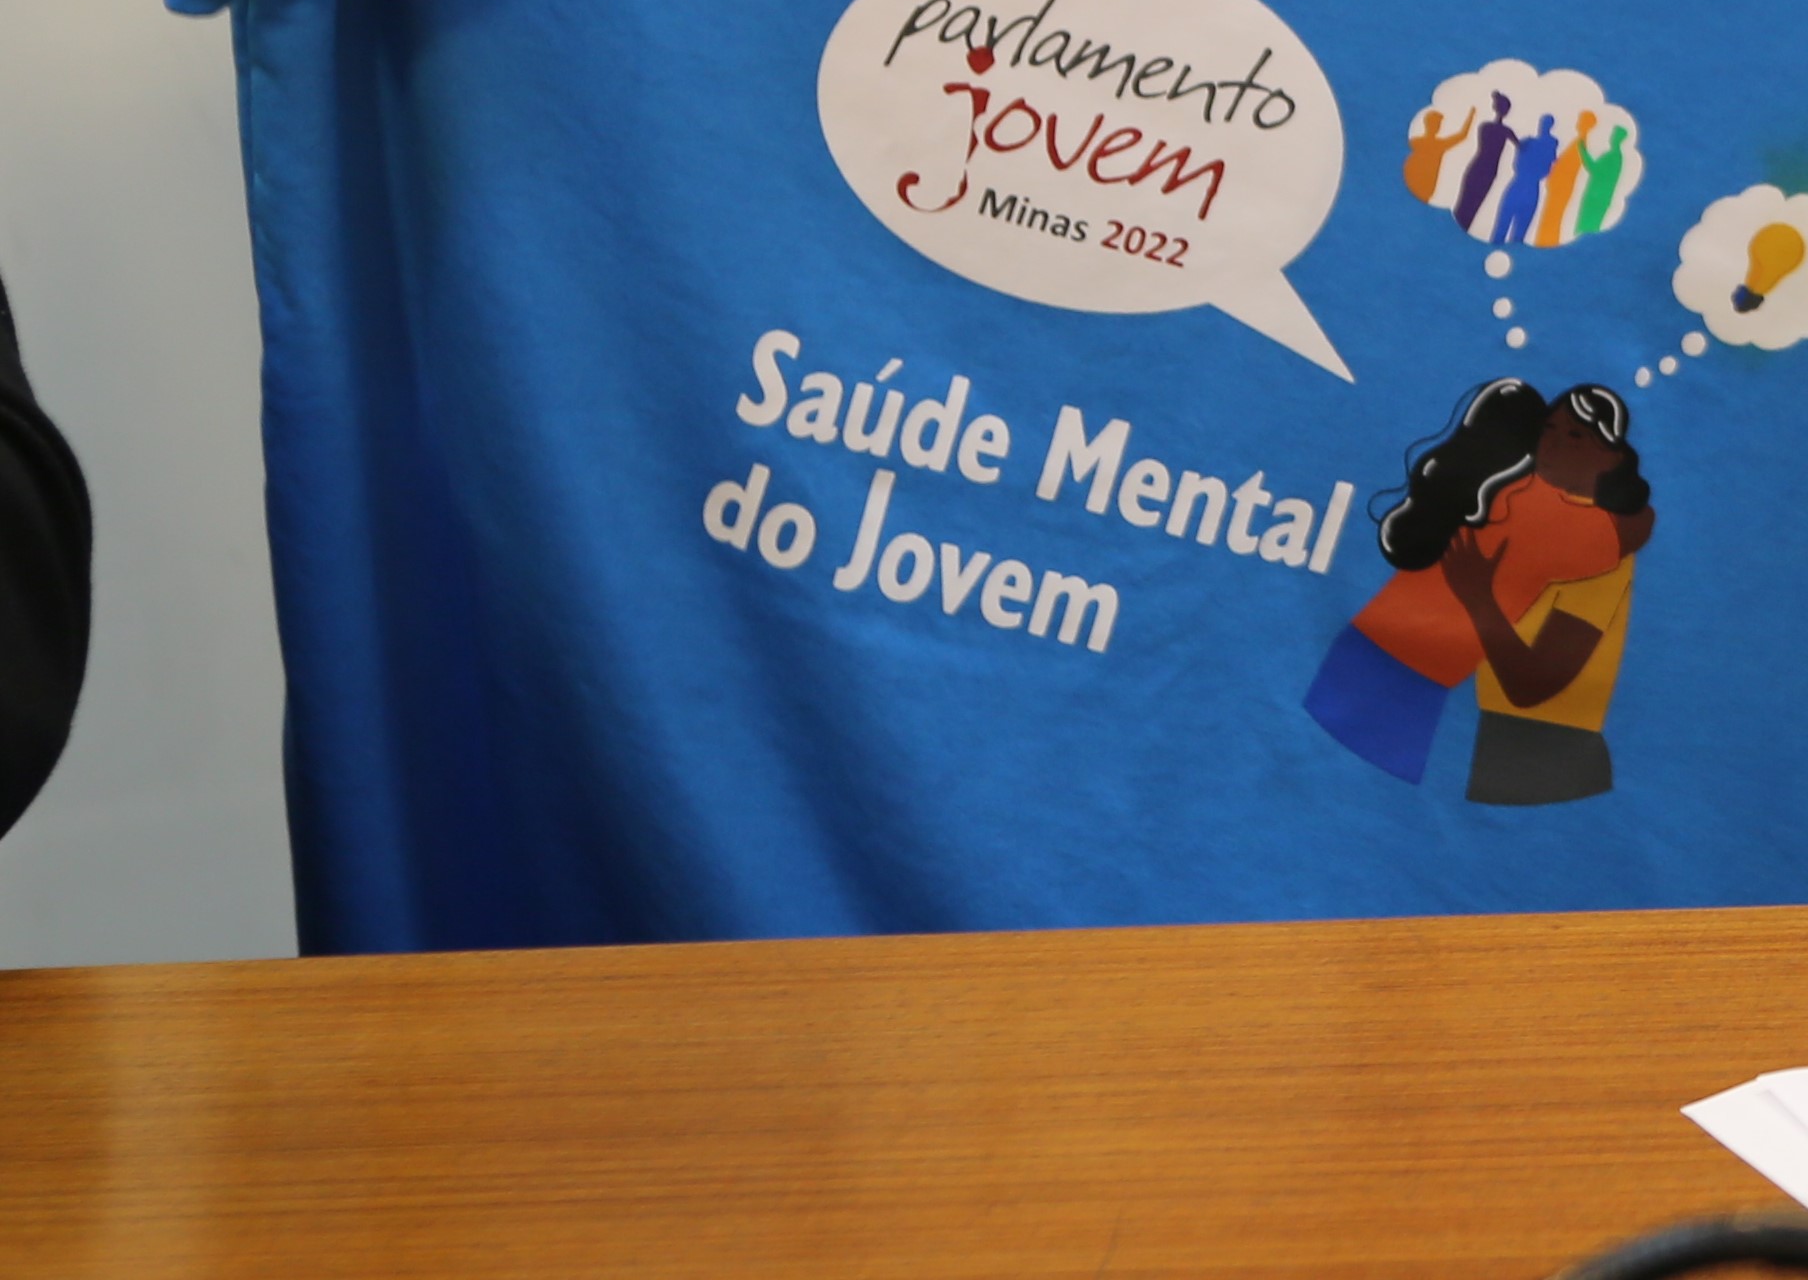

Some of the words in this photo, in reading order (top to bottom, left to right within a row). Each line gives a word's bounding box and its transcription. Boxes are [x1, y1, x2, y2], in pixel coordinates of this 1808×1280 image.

[978, 187, 1089, 243] Minas
[1100, 219, 1190, 269] 2022
[735, 329, 1011, 484] Saúde
[1036, 405, 1355, 575] Mental
[702, 463, 817, 569] do
[833, 468, 1120, 653] Jovem
